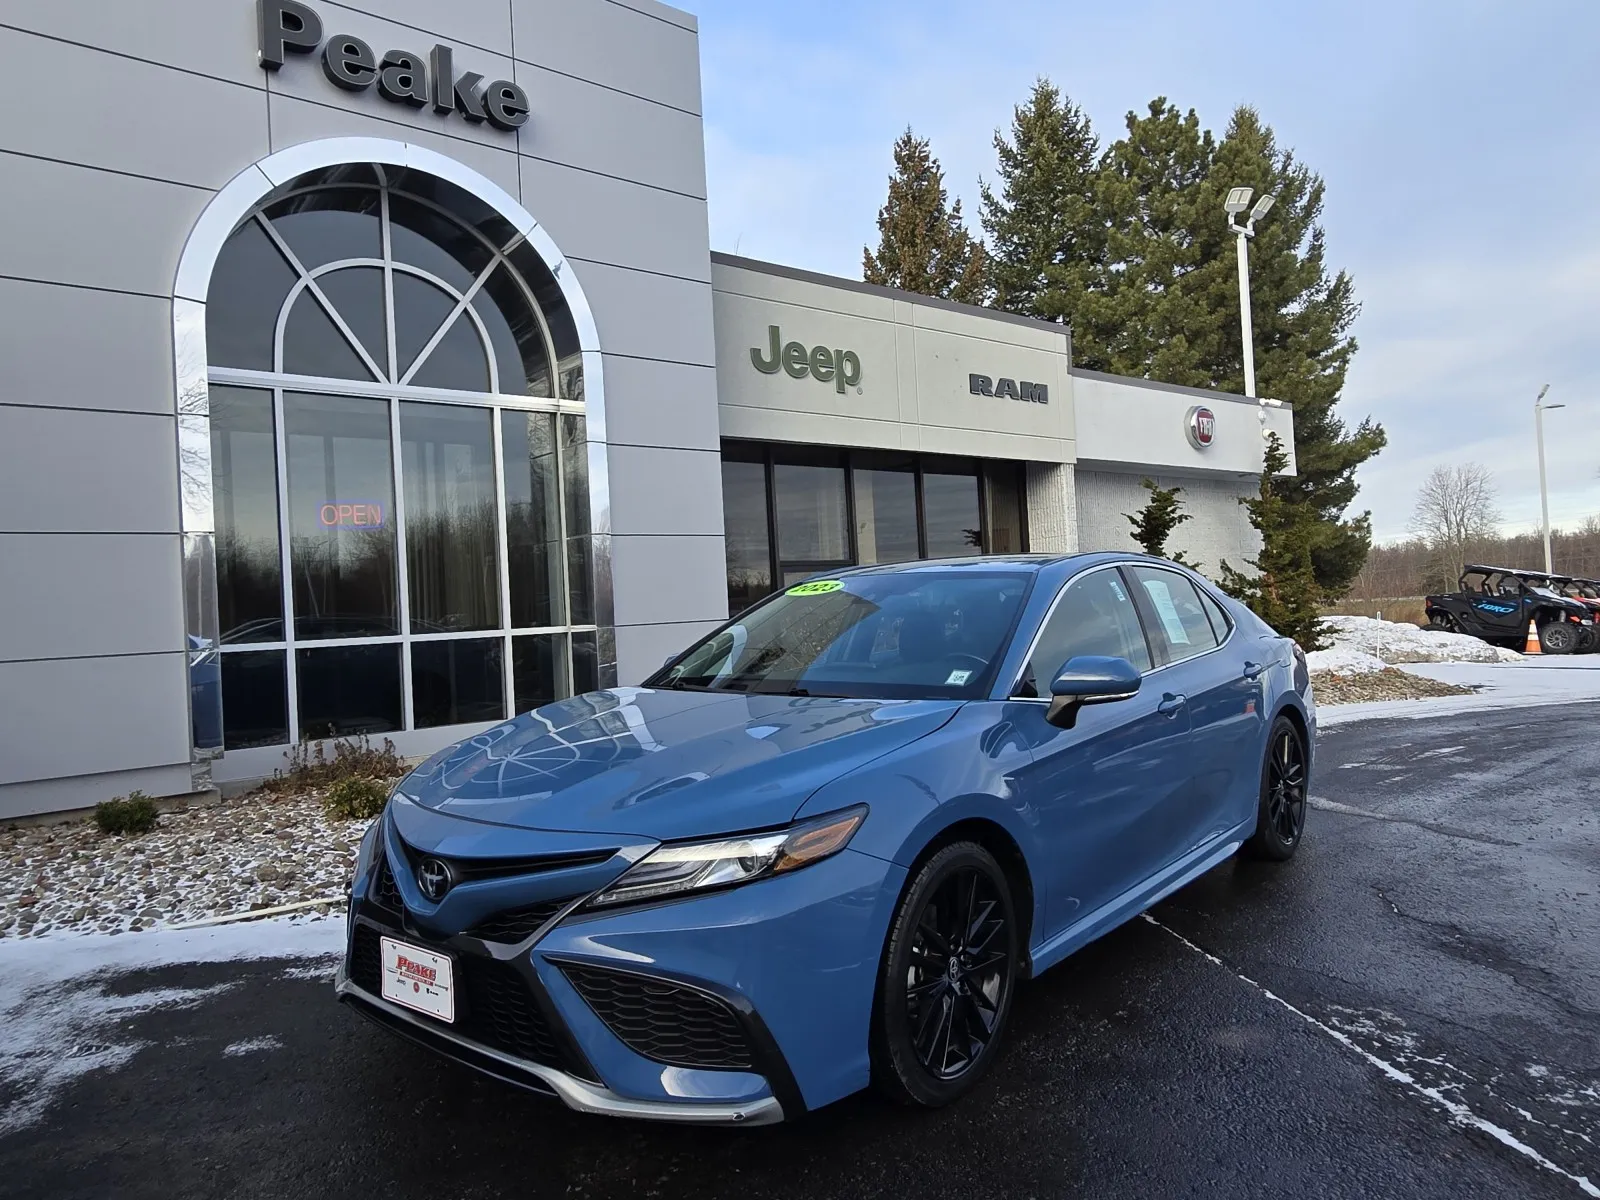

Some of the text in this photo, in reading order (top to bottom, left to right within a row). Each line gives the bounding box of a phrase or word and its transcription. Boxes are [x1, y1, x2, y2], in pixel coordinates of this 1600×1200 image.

[257, 0, 530, 131] Peake
[750, 325, 862, 393] Jeep
[969, 373, 1048, 404] RAM
[320, 504, 381, 526] OPEN
